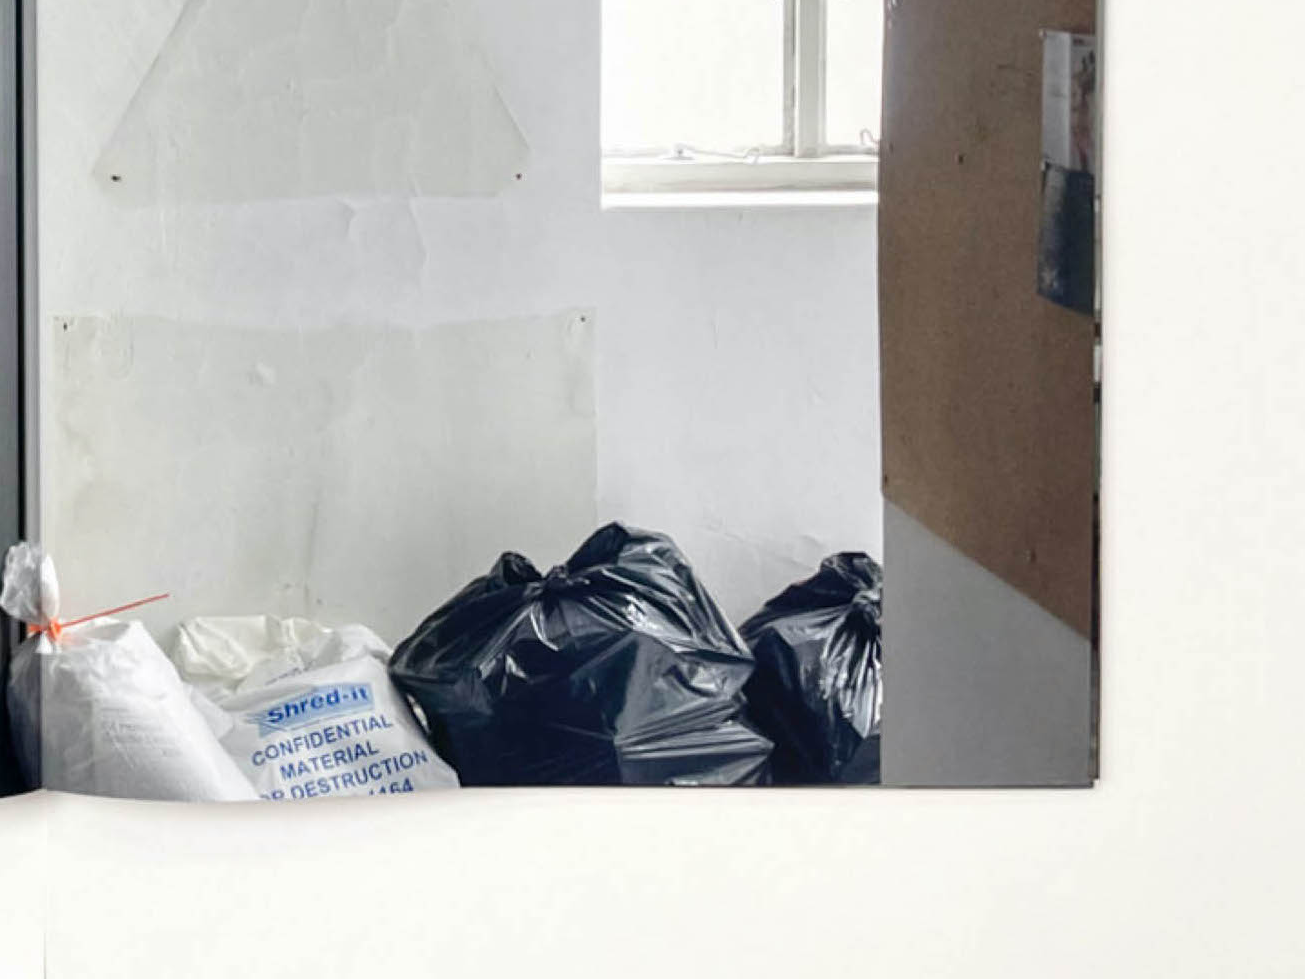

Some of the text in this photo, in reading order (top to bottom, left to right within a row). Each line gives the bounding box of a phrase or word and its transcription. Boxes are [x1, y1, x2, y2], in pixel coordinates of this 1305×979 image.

[251, 714, 393, 767] CONFIDENTIAL
[279, 740, 380, 781] MATERIAL
[290, 749, 428, 799] DESTRUCTION
